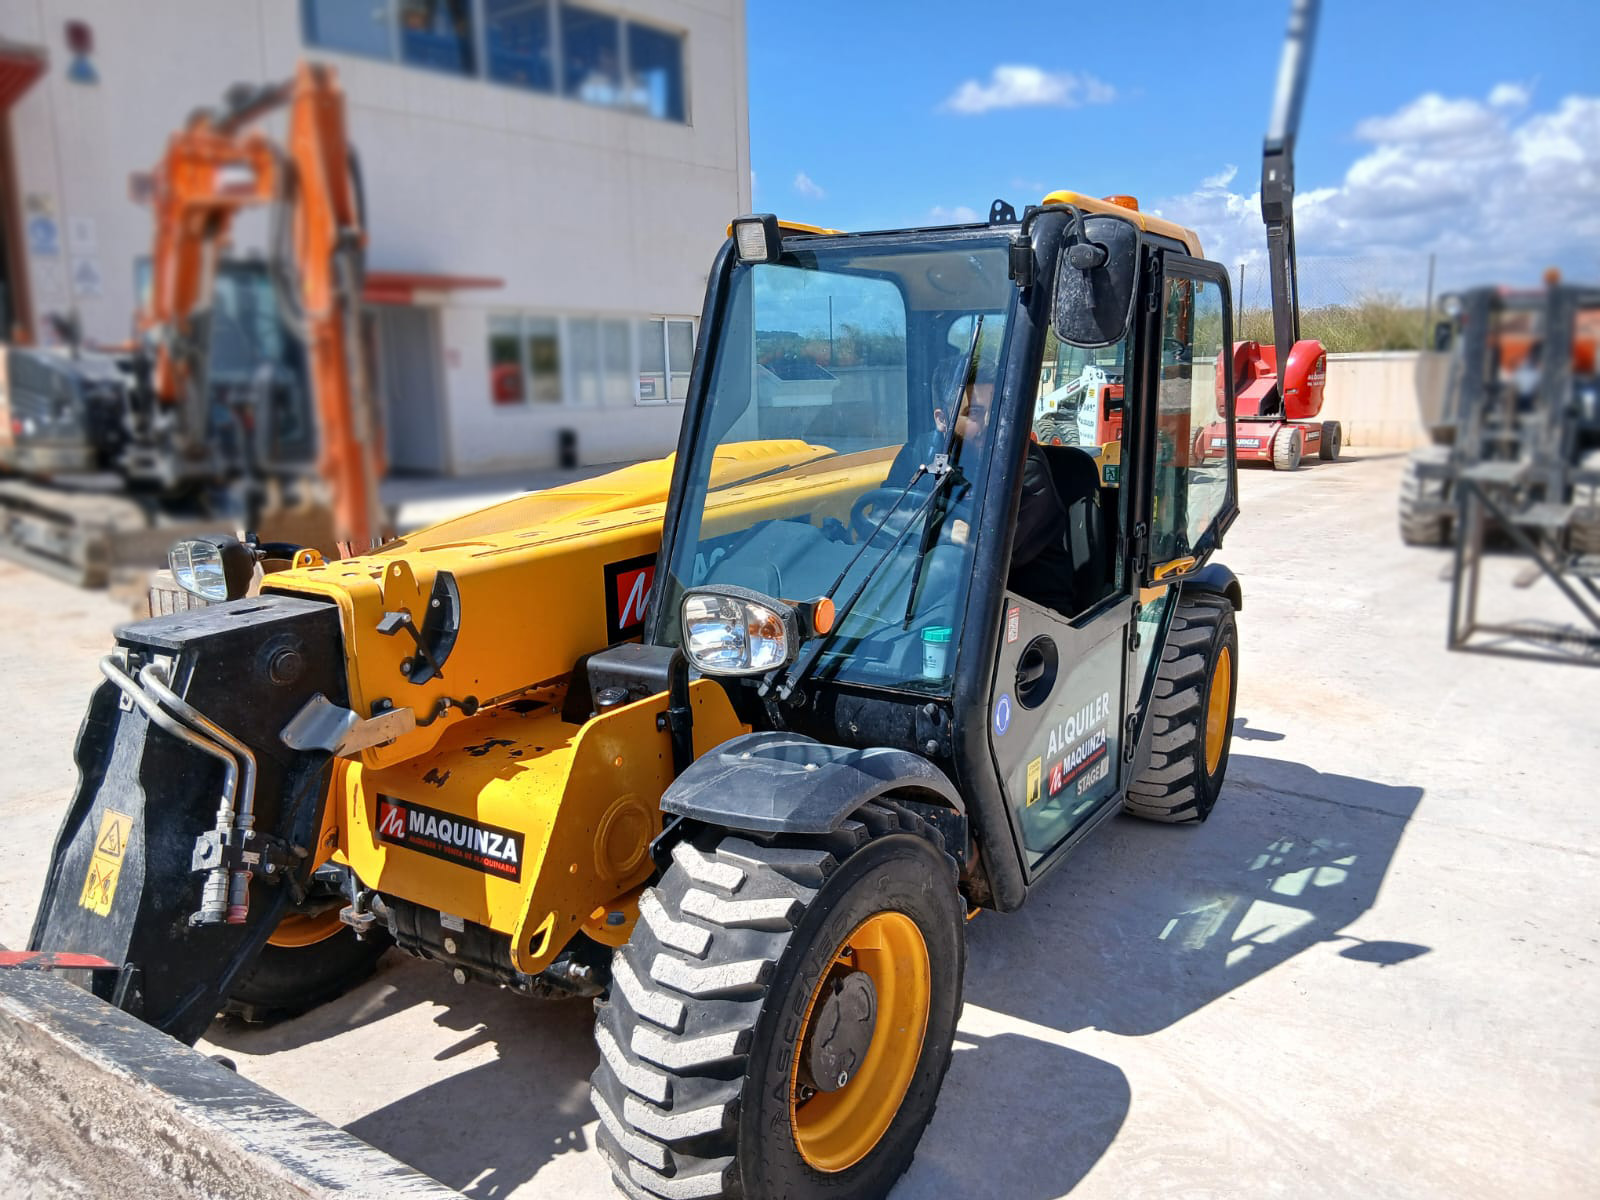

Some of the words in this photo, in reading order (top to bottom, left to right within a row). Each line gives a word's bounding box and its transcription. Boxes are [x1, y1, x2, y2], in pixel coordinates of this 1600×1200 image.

[1047, 692, 1110, 760] ALQUILER
[1063, 728, 1106, 776] MAQUINZA
[1077, 765, 1100, 796] STAGE
[409, 810, 518, 863] MAQUINZA
